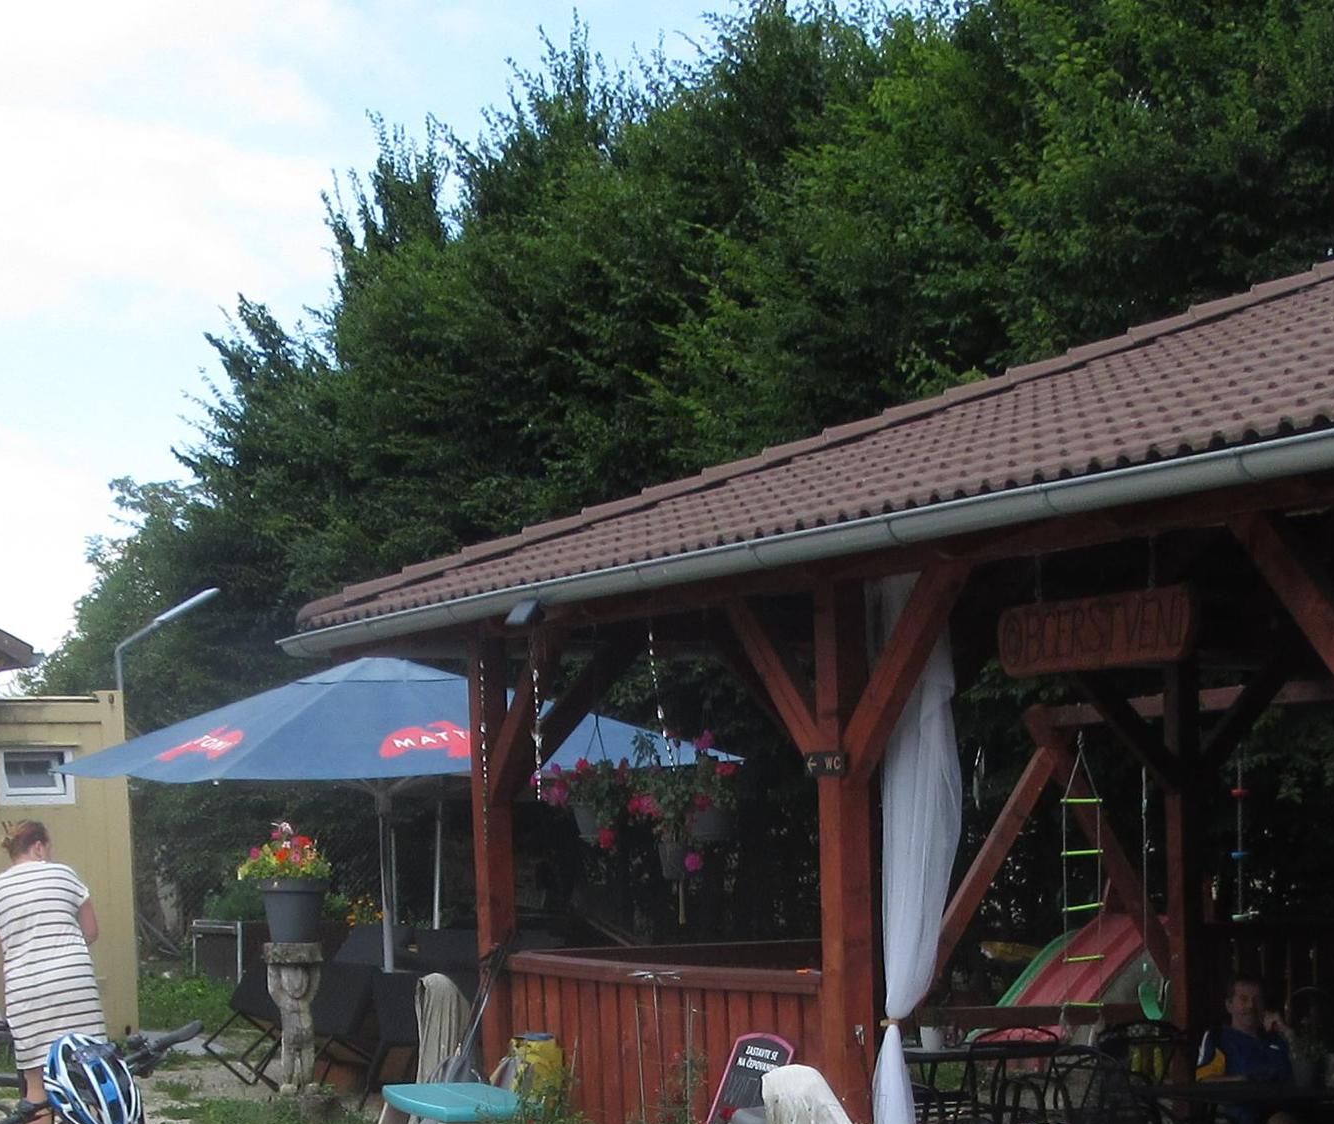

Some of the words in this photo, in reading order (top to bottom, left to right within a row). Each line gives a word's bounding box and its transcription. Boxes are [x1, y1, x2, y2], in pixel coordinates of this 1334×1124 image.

[393, 731, 467, 748] MATT
[824, 756, 842, 770] WC
[745, 1045, 771, 1059] ZASTAVTE
[737, 1057, 747, 1066] NA
